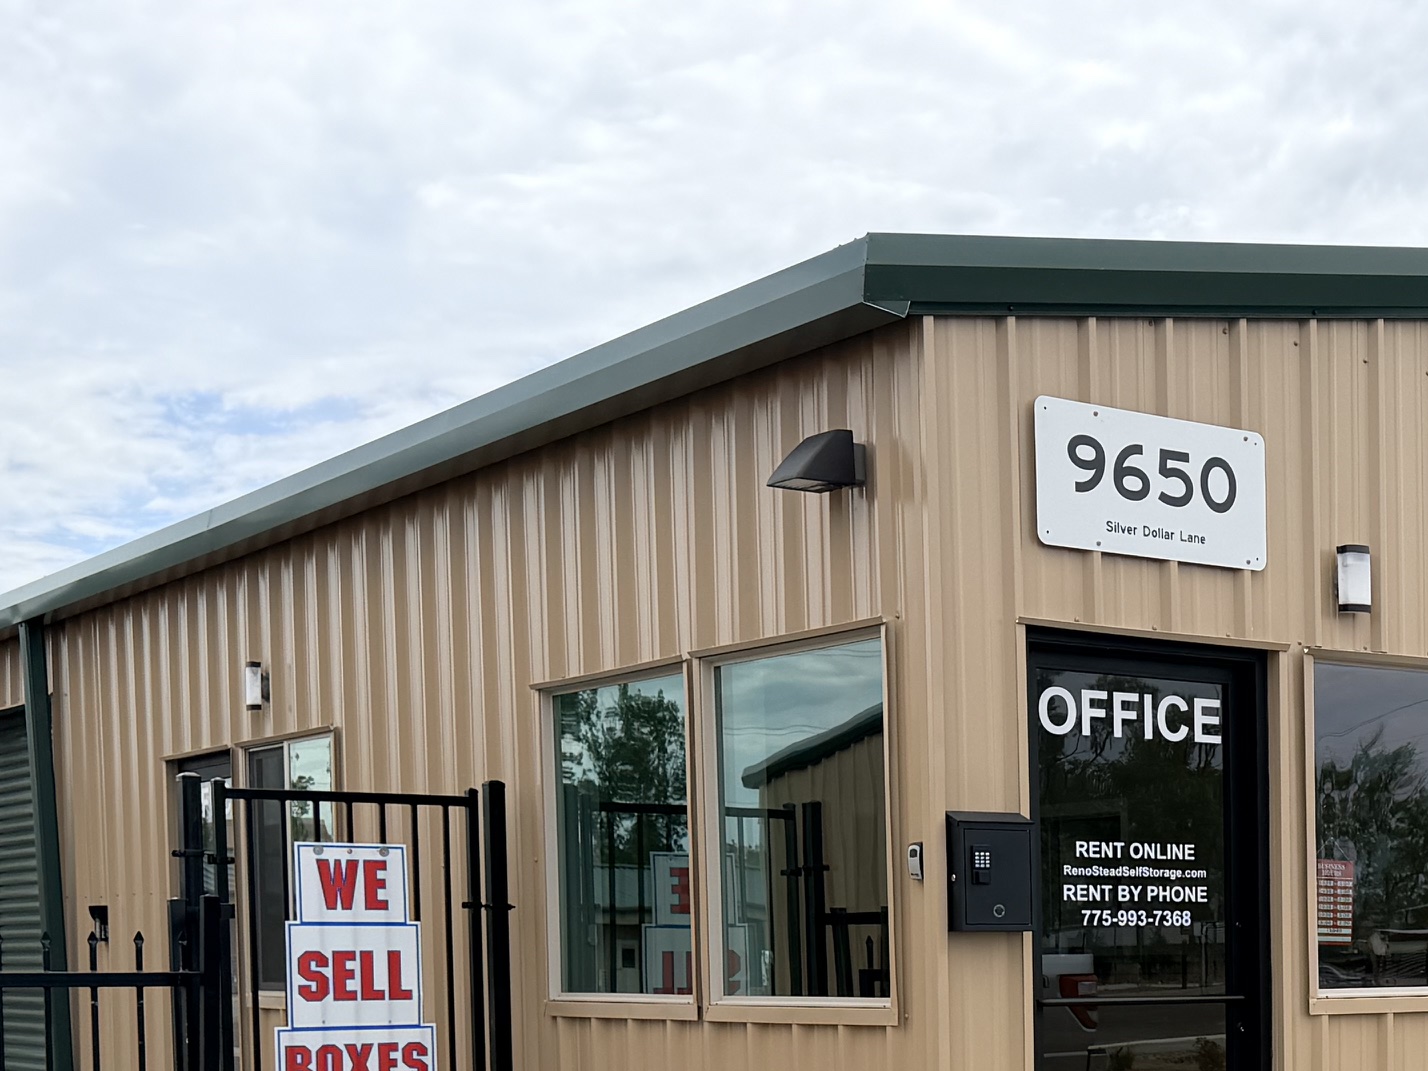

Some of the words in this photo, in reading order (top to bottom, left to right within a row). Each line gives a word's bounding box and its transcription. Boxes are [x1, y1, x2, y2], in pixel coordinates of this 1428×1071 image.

[1067, 434, 1237, 513] 9650
[1106, 520, 1137, 536] Silver
[1142, 525, 1175, 541] Dollar
[1179, 530, 1206, 544] Lane
[1038, 686, 1222, 744] OFFICE
[1075, 841, 1125, 858] RENT
[1129, 842, 1195, 860] ONLINE
[1063, 864, 1207, 880] RenoSteadSelfStorage.com
[315, 858, 389, 911] WE
[1063, 884, 1113, 901] RENT
[1117, 885, 1143, 902] BY
[1147, 886, 1208, 902] PHONE
[1081, 909, 1191, 927] 775-993-7368
[297, 950, 413, 1002] SELL
